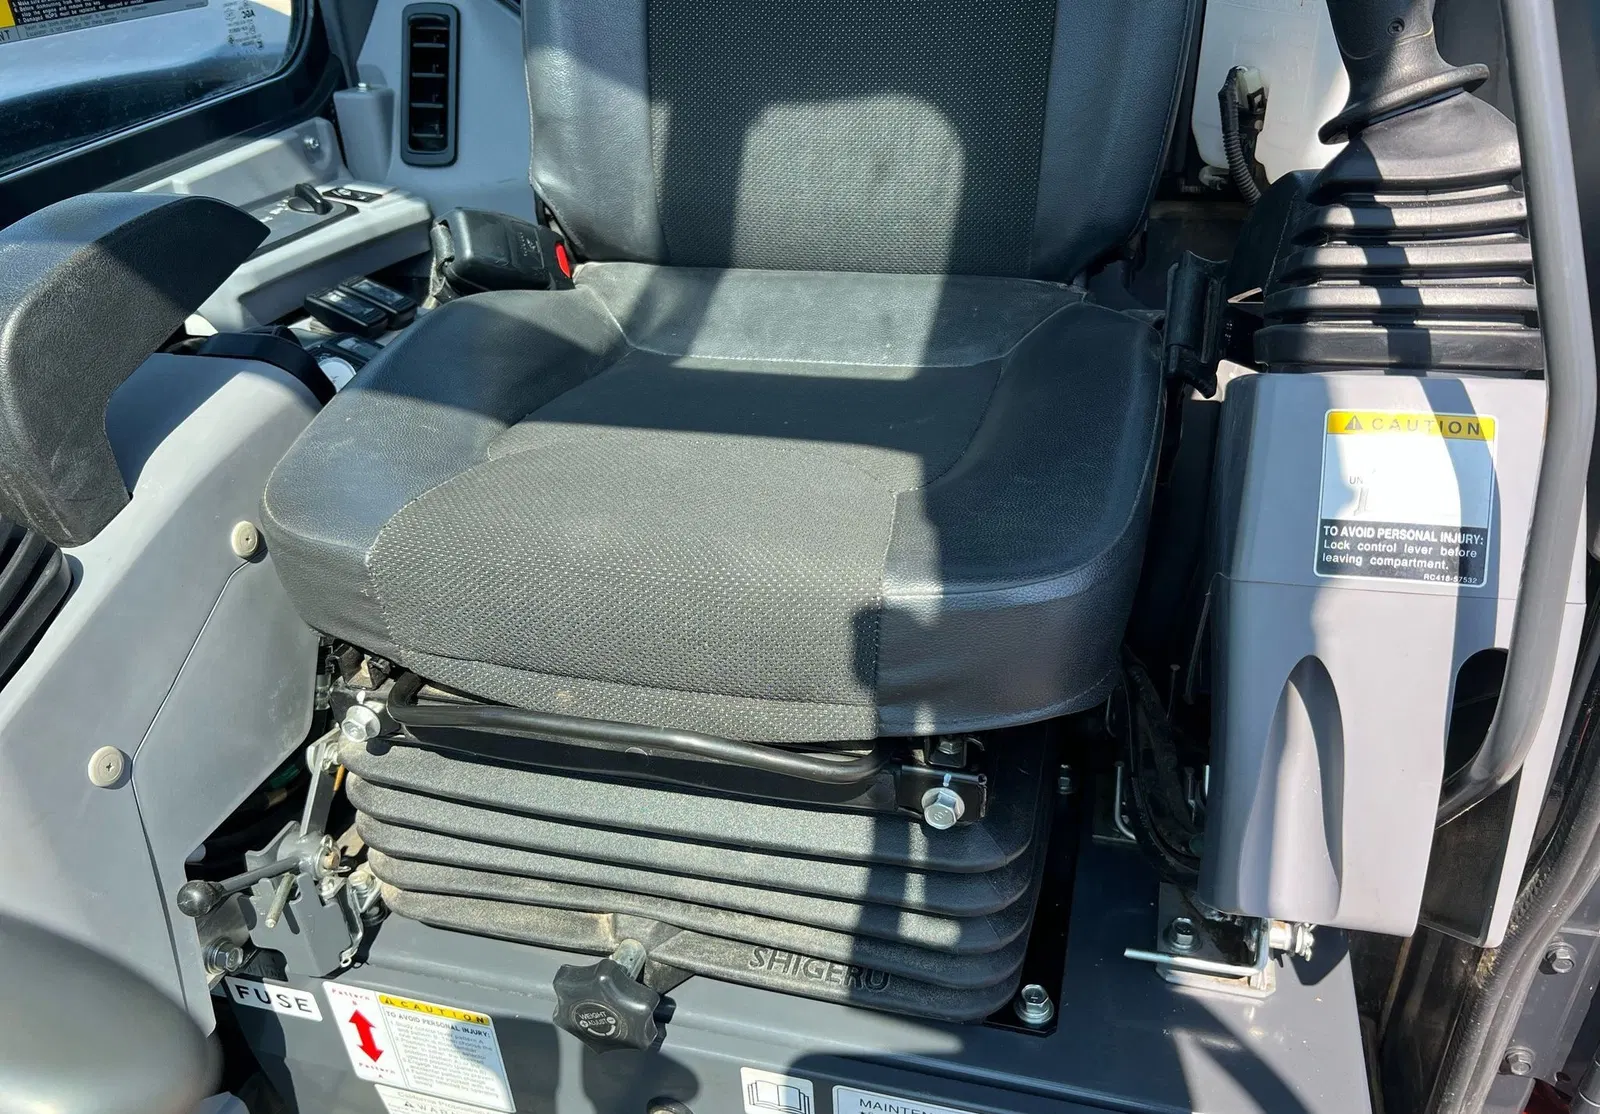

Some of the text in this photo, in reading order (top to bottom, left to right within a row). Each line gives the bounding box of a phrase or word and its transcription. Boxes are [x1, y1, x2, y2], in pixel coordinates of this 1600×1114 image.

[1372, 418, 1480, 436] CAUTION
[1323, 525, 1485, 545] TO AVOID PERSONAL INJURY:
[1323, 540, 1478, 558] Lock control lever before
[1322, 553, 1450, 571] leaving compartment.
[748, 946, 891, 992] SHIGERU
[234, 984, 313, 1014] FUSE
[331, 987, 371, 1001] Pattern
[385, 1010, 397, 1018] TO
[398, 1013, 421, 1024] AVOID
[422, 1018, 460, 1032] PERSONAL
[400, 1000, 485, 1024] CAUTION
[579, 1011, 607, 1020] WEIGHT
